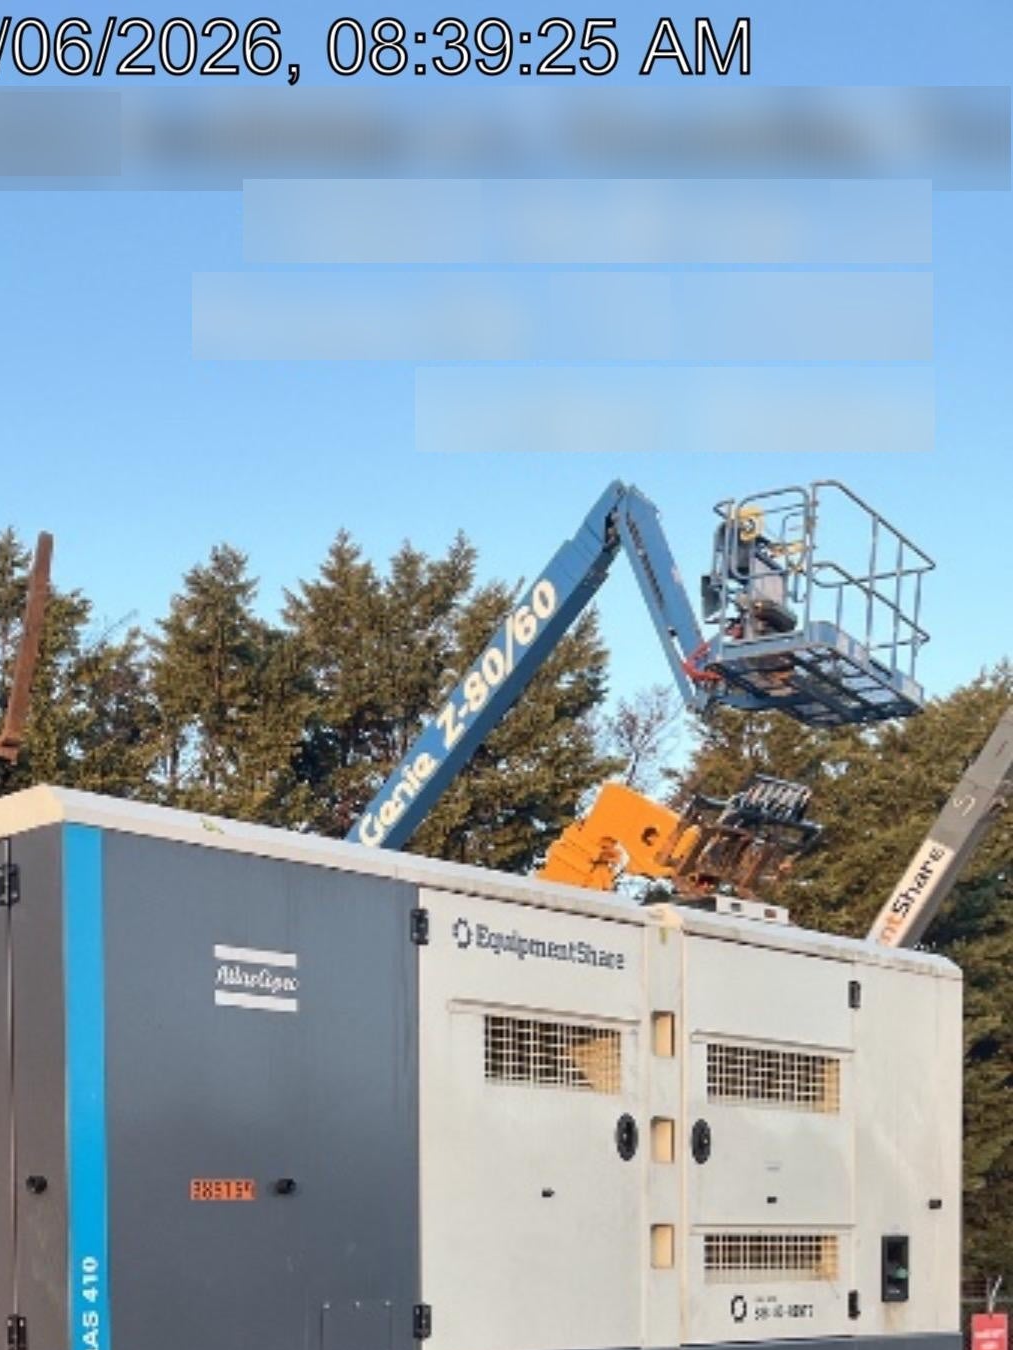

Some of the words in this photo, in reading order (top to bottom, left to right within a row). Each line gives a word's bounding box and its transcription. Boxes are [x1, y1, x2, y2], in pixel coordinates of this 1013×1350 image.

[358, 751, 439, 848] Genie
[436, 579, 557, 750] Z-80/60
[475, 923, 625, 970] EquipmentShare
[82, 1256, 99, 1303] 410
